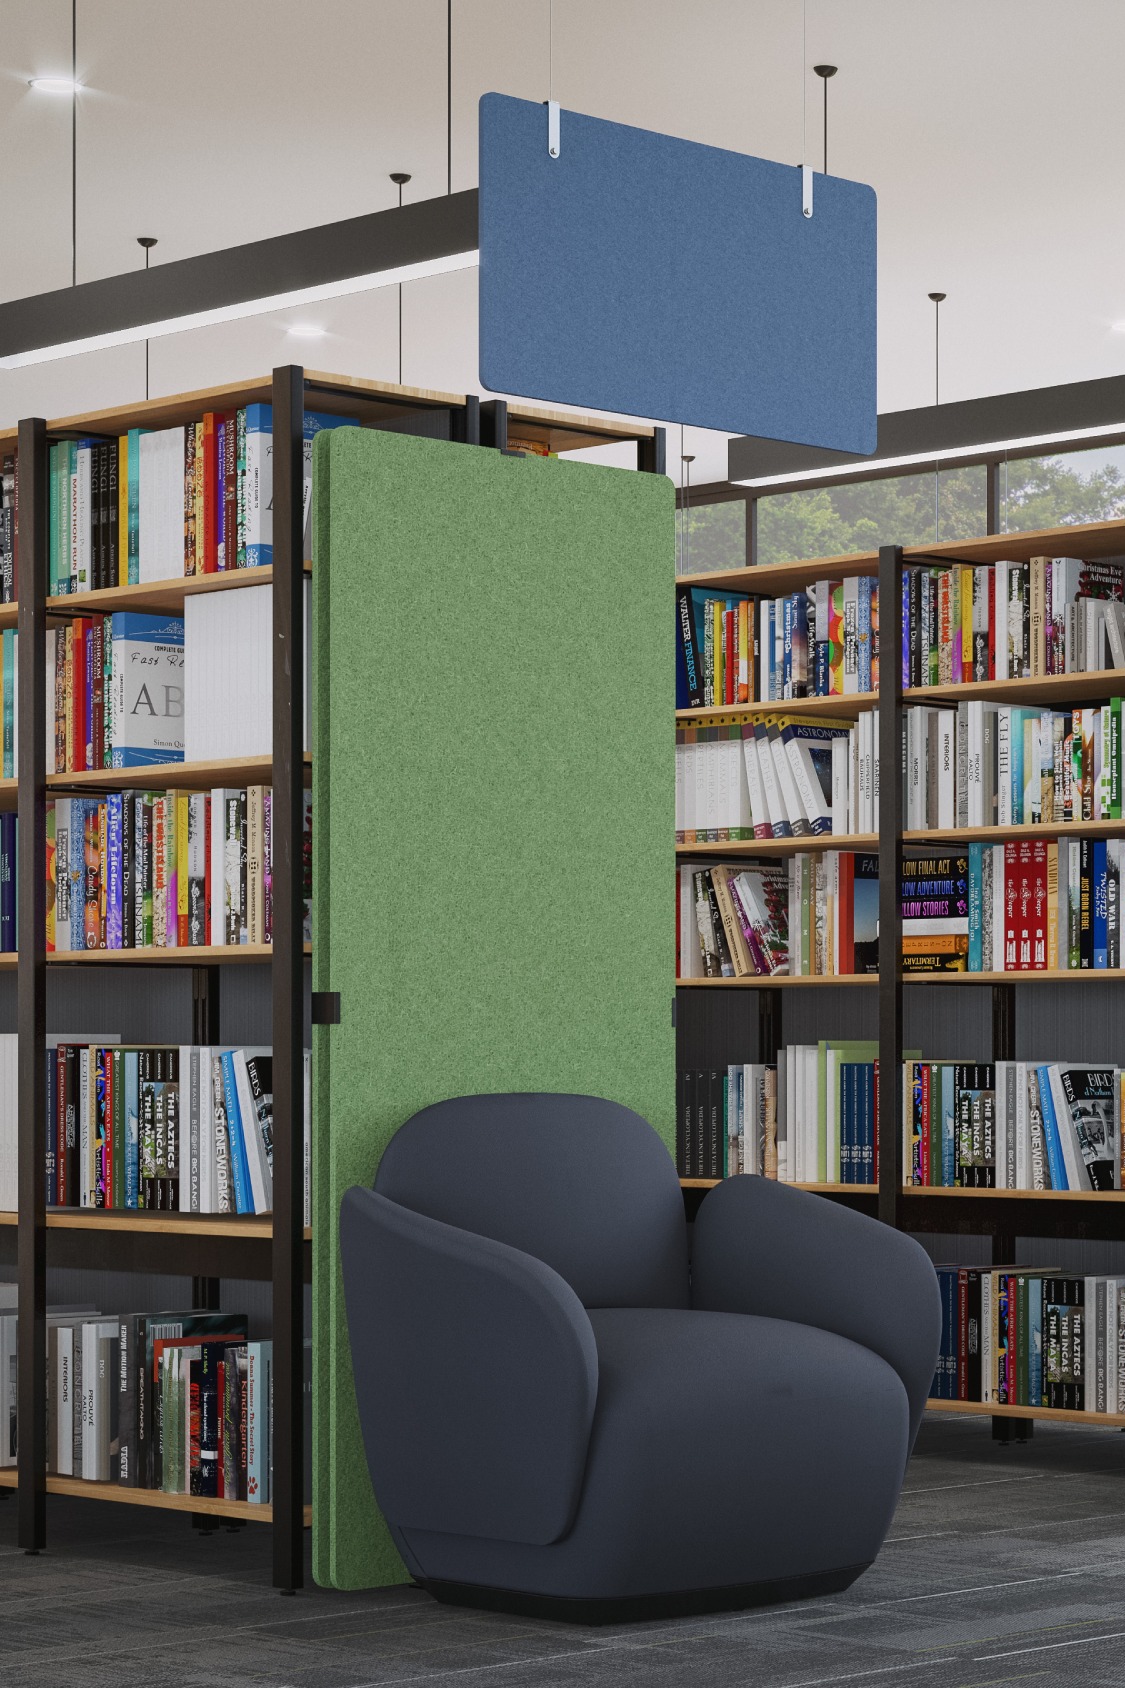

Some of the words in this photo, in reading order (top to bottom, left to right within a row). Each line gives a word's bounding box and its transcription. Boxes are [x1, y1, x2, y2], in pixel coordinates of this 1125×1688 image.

[1090, 573, 1123, 585] Adventure
[680, 596, 691, 642] WALTER
[130, 652, 160, 666] Fast
[684, 641, 697, 691] FINANCE
[797, 726, 849, 738] ASTRONOMY
[1083, 775, 1092, 794] Star
[1083, 797, 1092, 820] Child
[902, 861, 917, 876] LOW
[918, 860, 937, 875] FINAL
[938, 859, 951, 874] ACT
[1048, 857, 1058, 895] SANDMAN
[902, 882, 917, 896] LOW
[917, 880, 955, 896] ADVENTURE
[922, 900, 949, 916] STORIES
[903, 957, 941, 967] TERMITARY
[248, 1061, 260, 1096] BIRDS
[1062, 1074, 1076, 1102] BIRDS
[214, 1107, 228, 1209] STONEWORKS
[1030, 1109, 1043, 1191] STONEWORKS
